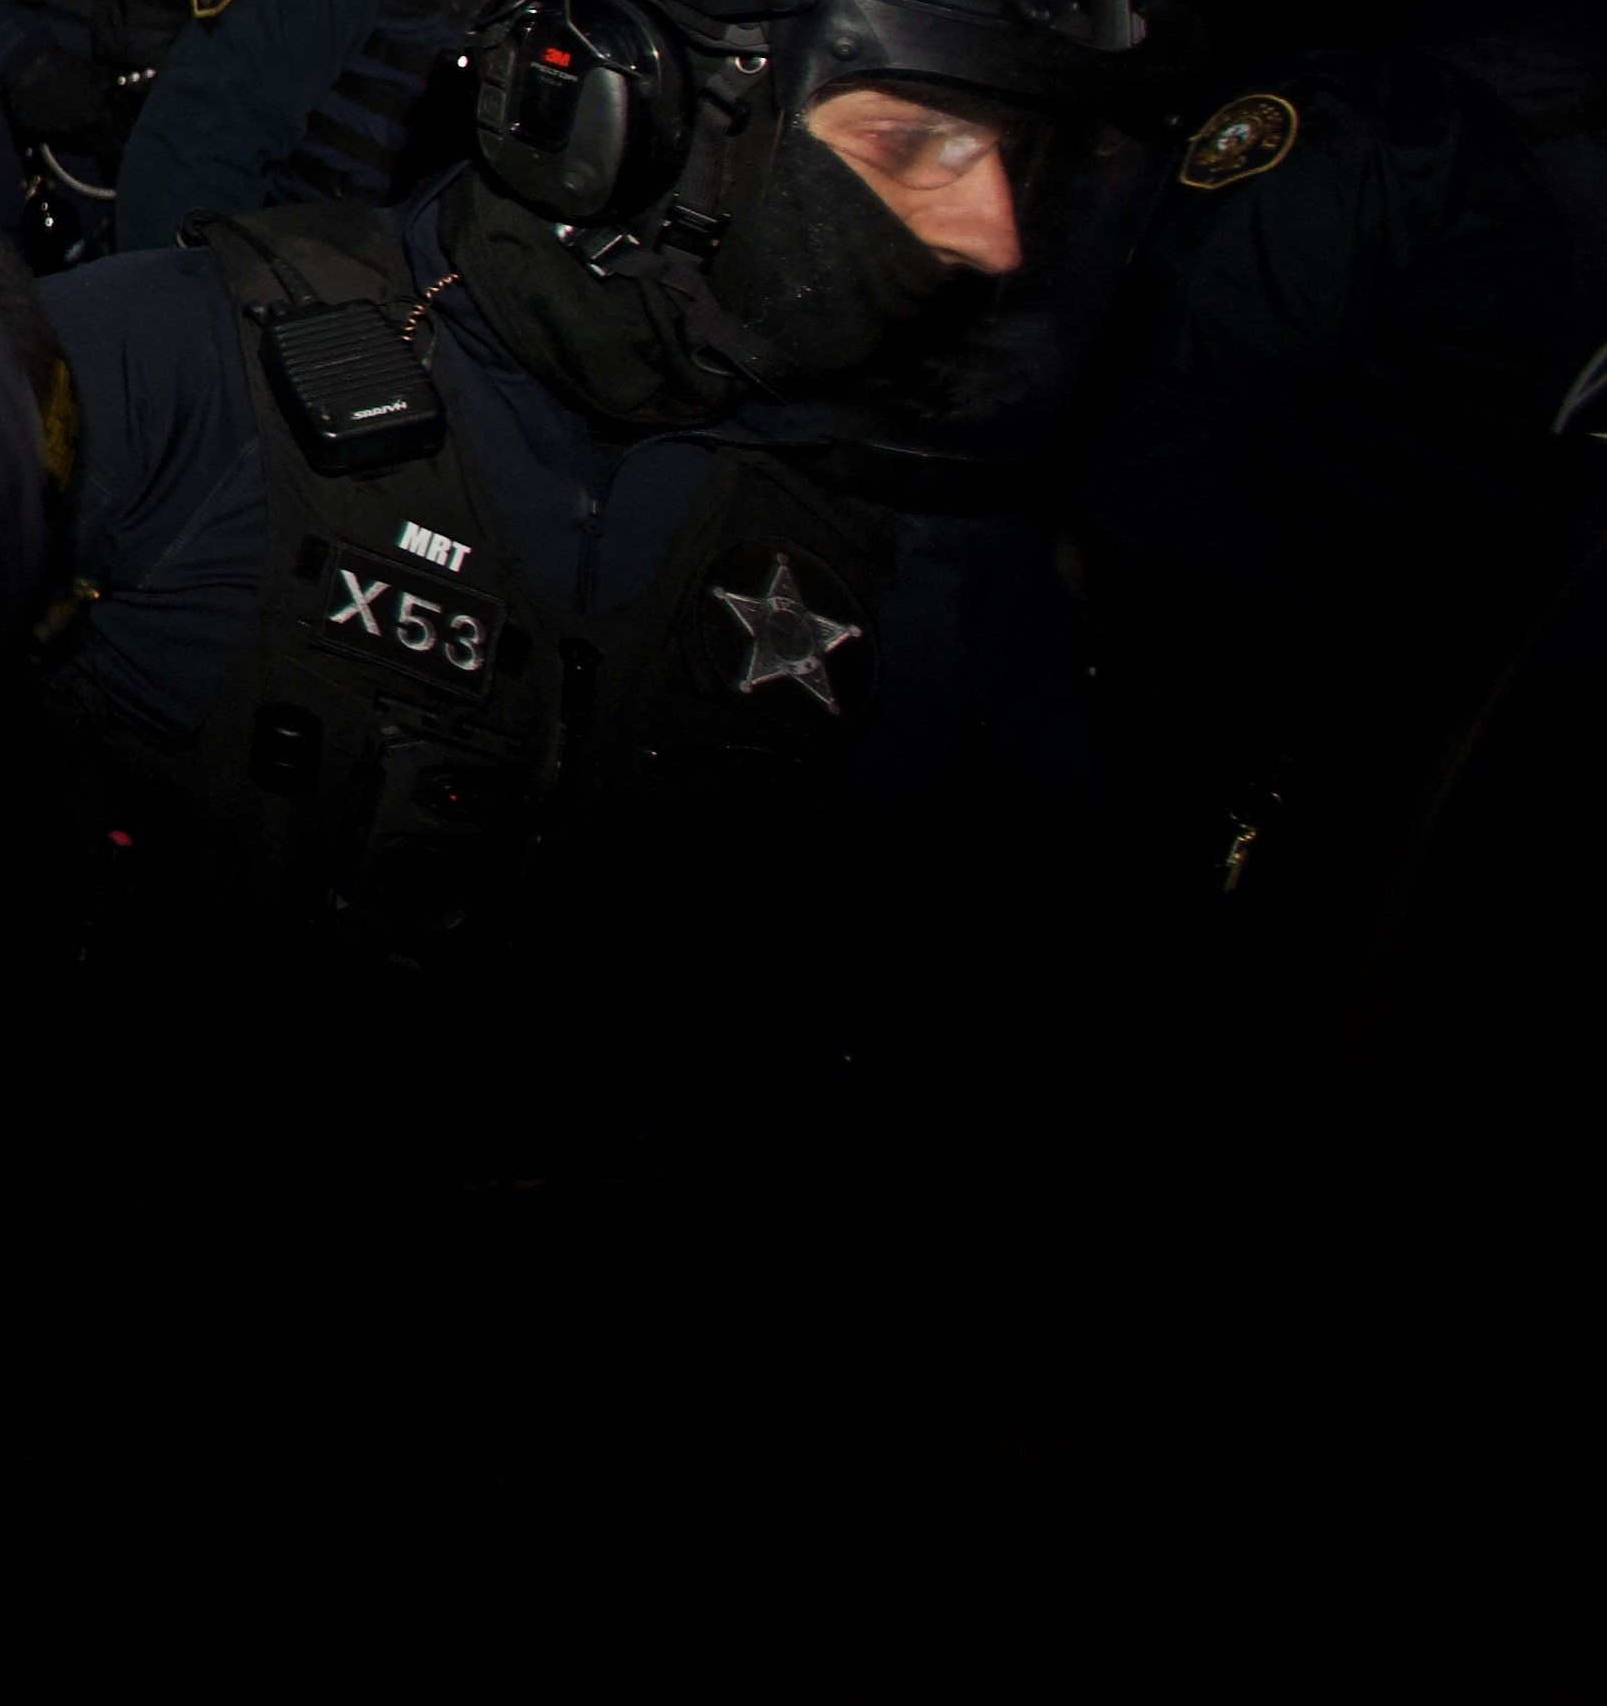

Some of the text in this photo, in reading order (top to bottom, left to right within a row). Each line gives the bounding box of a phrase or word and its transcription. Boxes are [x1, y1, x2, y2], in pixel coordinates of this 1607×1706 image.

[544, 47, 573, 68] 3M
[397, 520, 473, 573] MRT
[328, 568, 486, 671] X53
